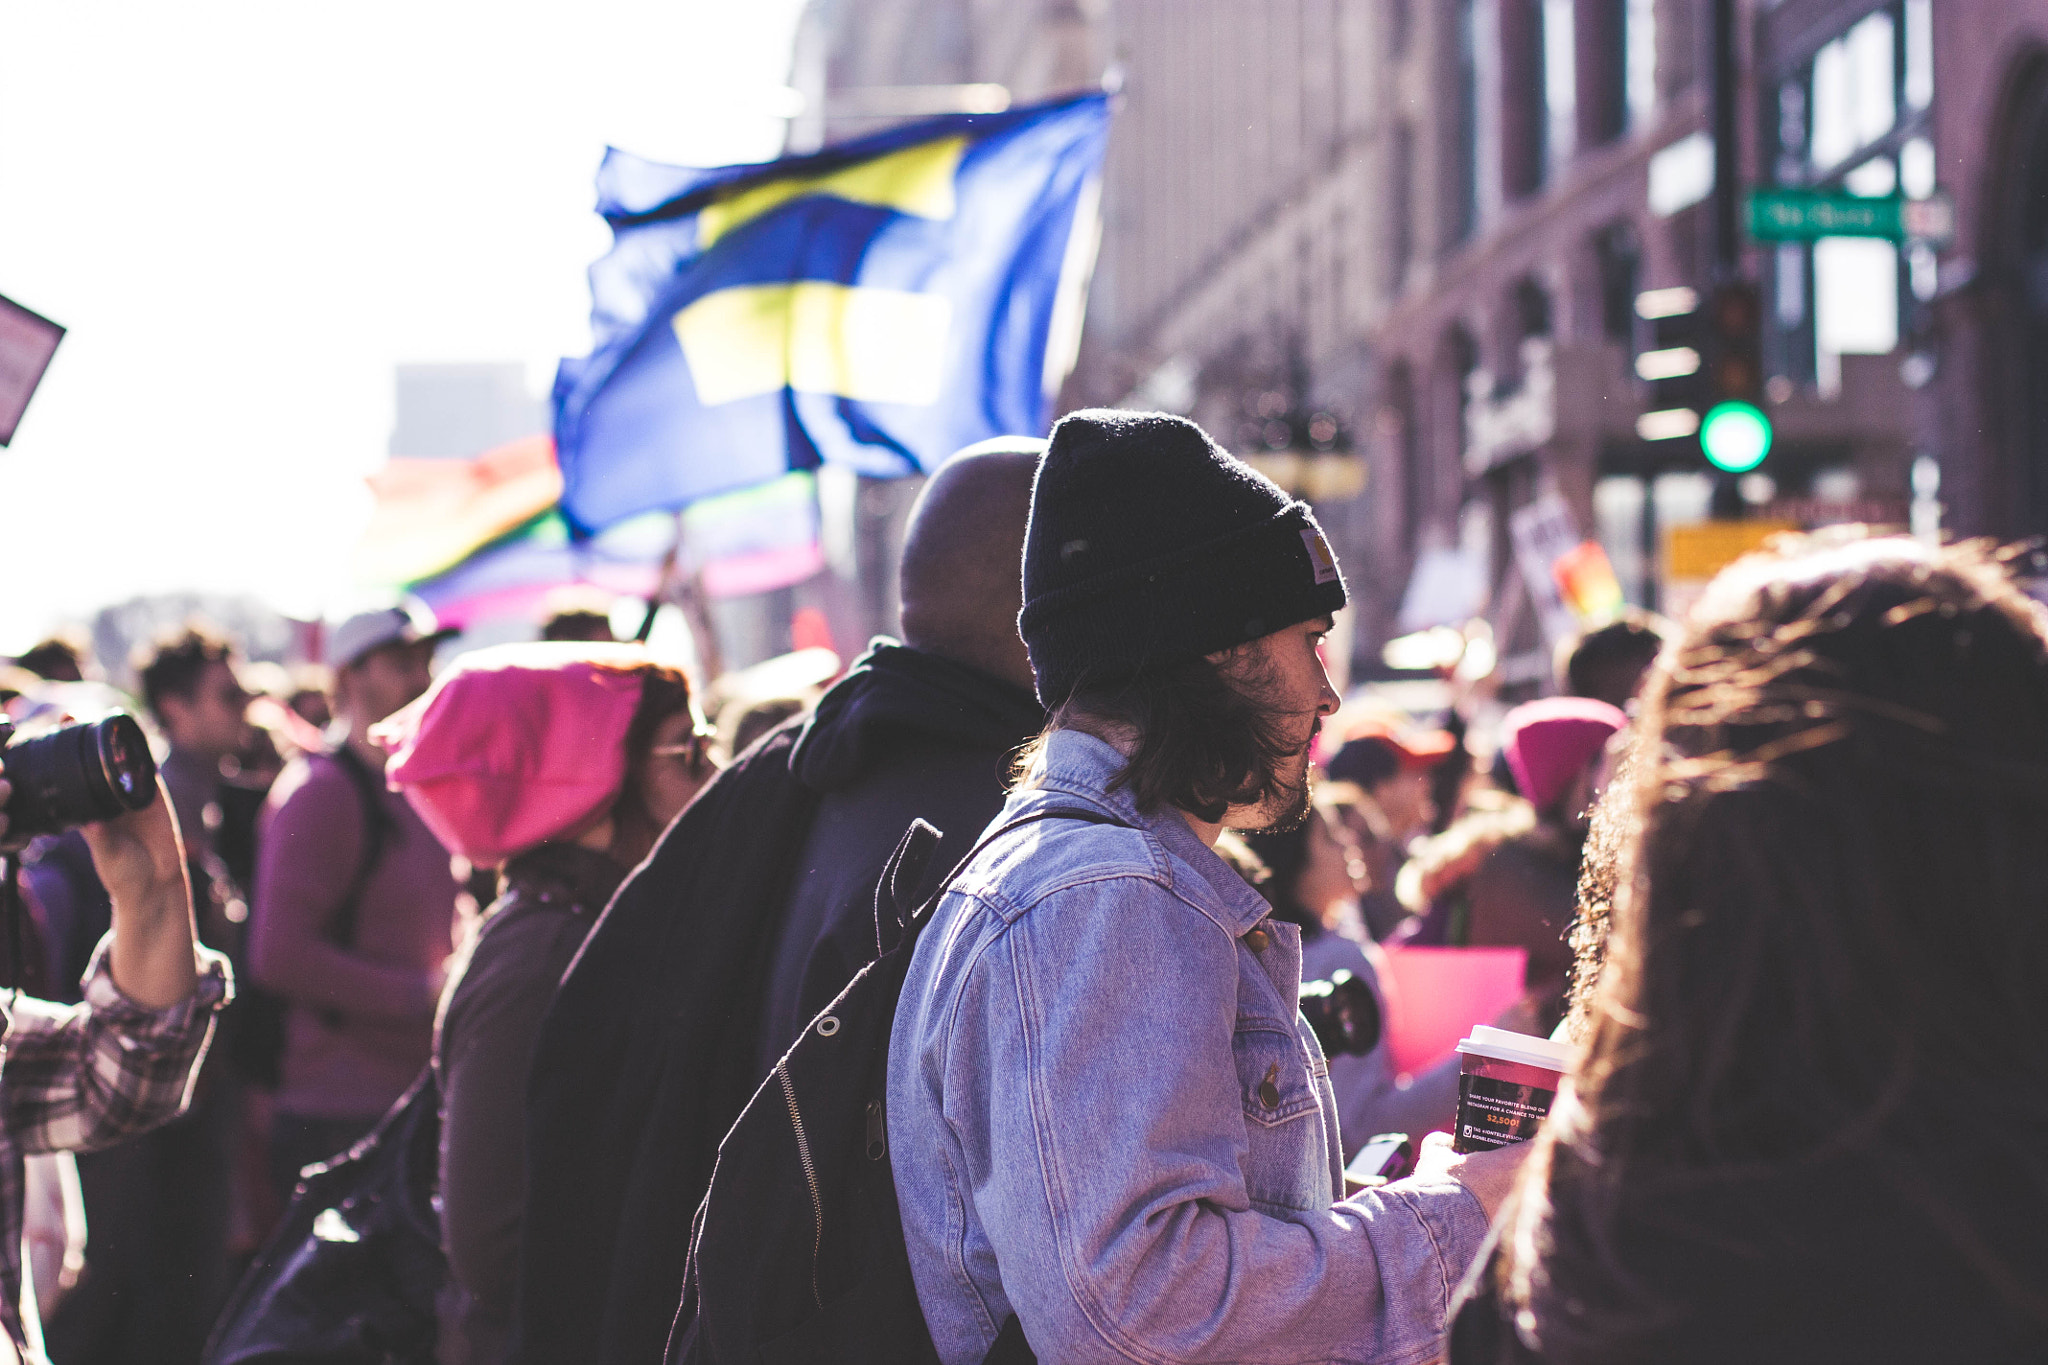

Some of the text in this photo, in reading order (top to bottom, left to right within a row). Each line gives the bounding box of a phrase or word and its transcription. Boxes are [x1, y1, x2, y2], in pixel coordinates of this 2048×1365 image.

[1495, 1098, 1520, 1108] FAVORITE
[1520, 1103, 1537, 1111] BLEND
[1505, 1109, 1527, 1118] CHANCE
[1487, 1114, 1520, 1127] $2,500!
